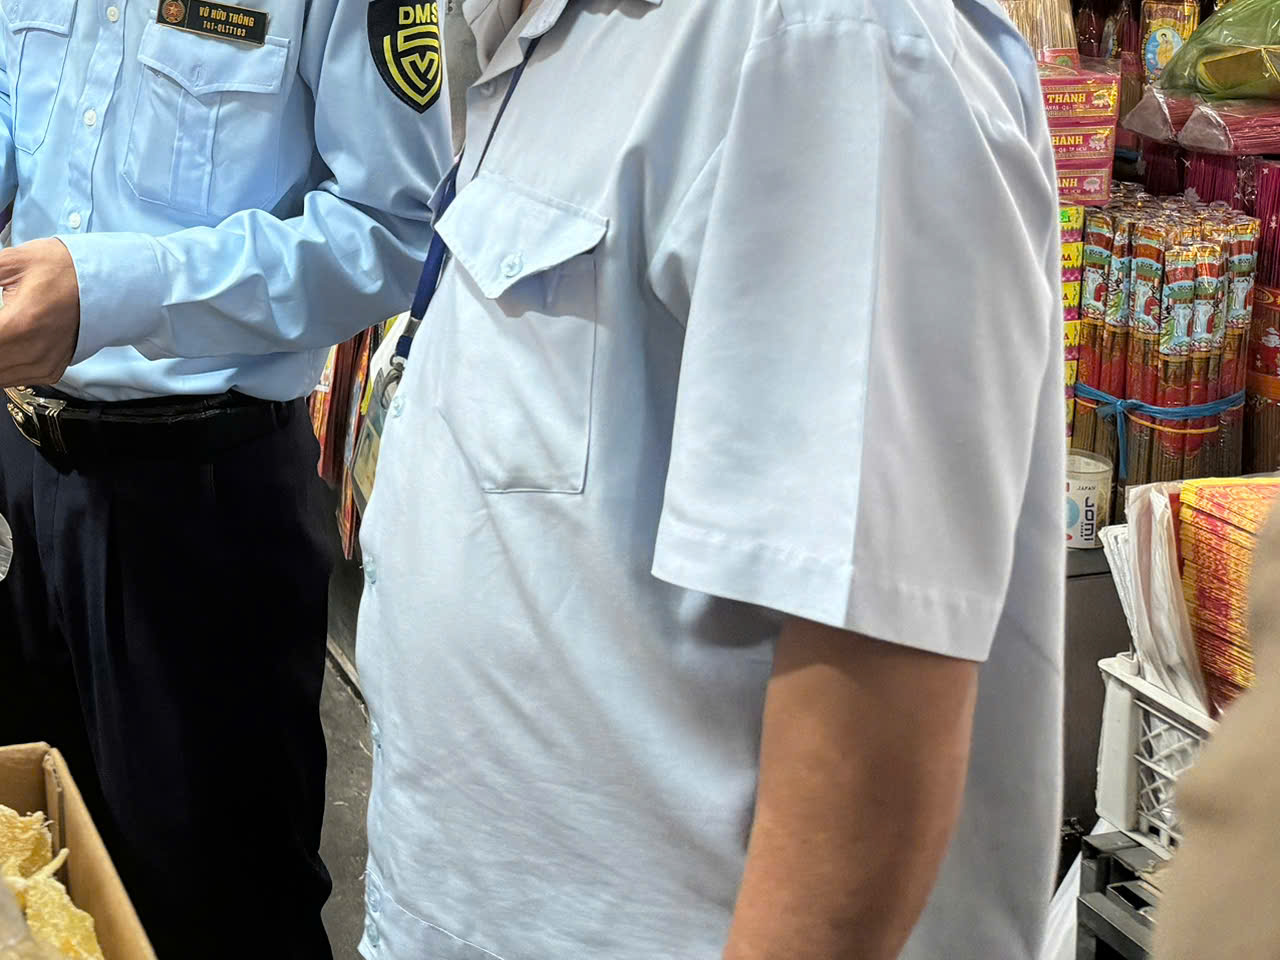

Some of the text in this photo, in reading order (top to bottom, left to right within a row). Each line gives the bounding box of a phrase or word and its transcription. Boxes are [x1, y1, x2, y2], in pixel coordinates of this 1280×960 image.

[199, 6, 255, 28] VŨ HỮU THÔNG
[399, 2, 439, 25] DMS
